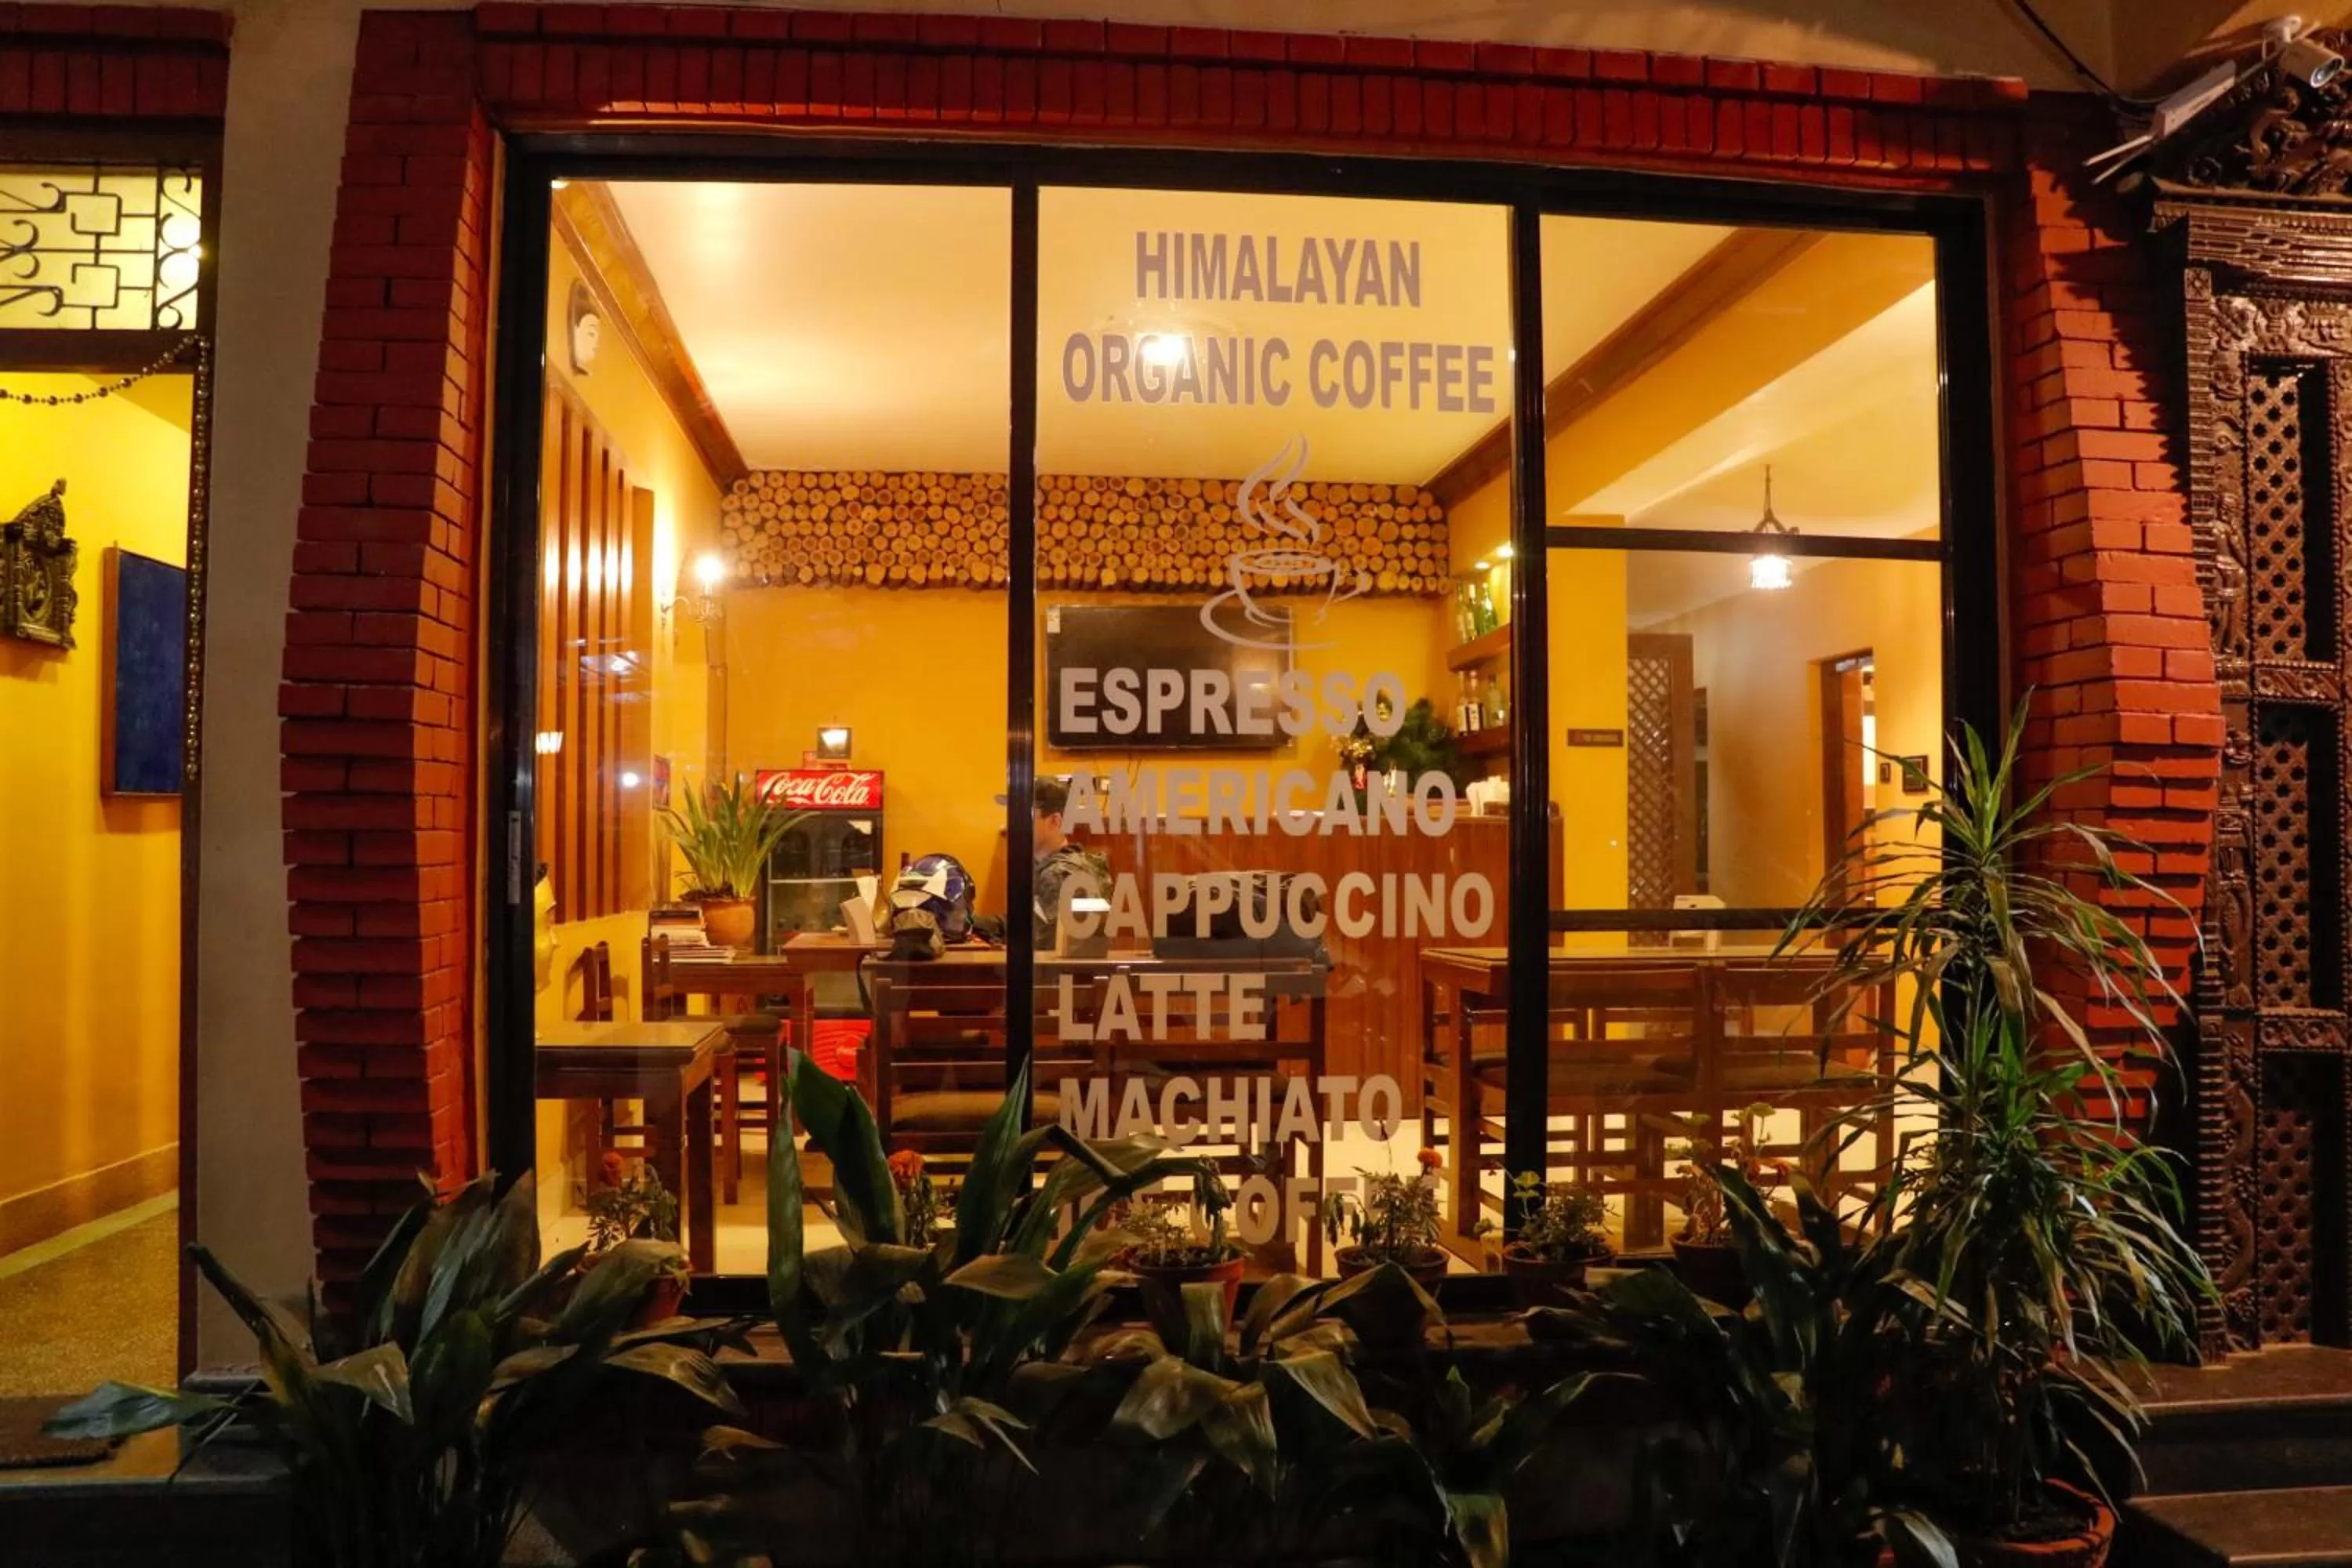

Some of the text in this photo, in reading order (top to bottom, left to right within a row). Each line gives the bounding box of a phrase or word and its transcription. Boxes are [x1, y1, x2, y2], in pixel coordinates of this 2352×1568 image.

[1136, 231, 1421, 307] HIMALAYAN
[1062, 333, 1495, 414] ORGANIC COFFEE
[1058, 667, 1406, 735] ESPRESSO
[1062, 769, 1457, 837] AMERICANO
[1057, 872, 1495, 940] CAPPUCCINO
[1058, 974, 1266, 1041] LATTE
[1058, 1076, 1402, 1145] MACHIATO
